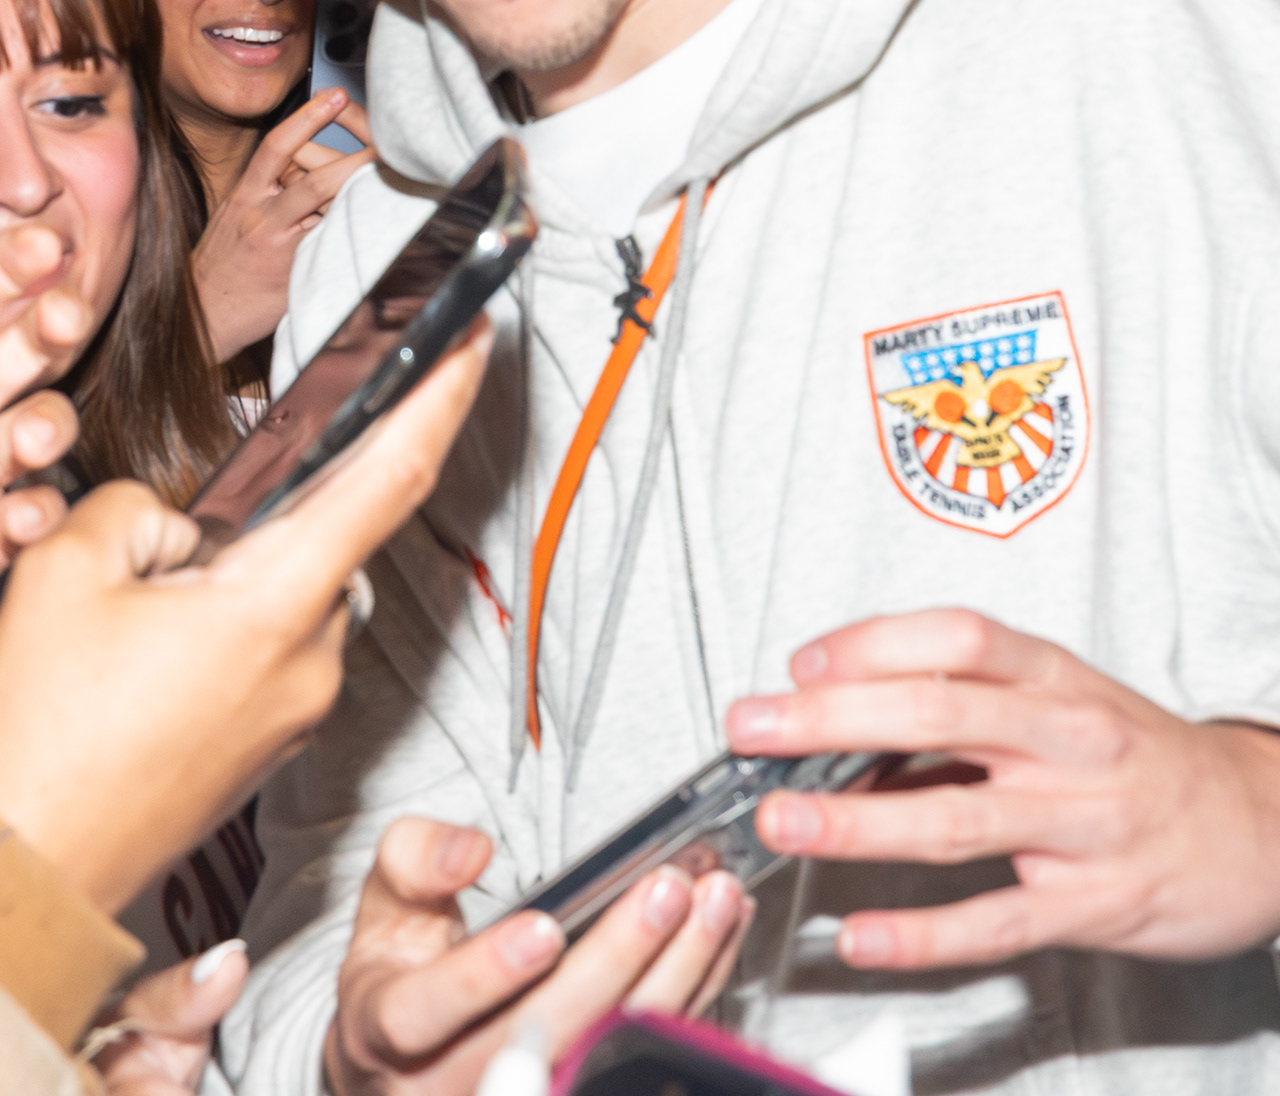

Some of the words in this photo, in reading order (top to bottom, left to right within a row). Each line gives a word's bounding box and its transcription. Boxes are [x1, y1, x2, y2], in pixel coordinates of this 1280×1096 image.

[872, 322, 943, 356] MARTY
[950, 300, 1059, 338] SUPREME
[892, 422, 920, 481] TABLE
[920, 482, 987, 519] TENNIS
[1011, 394, 1075, 513] ASSOCIATION
